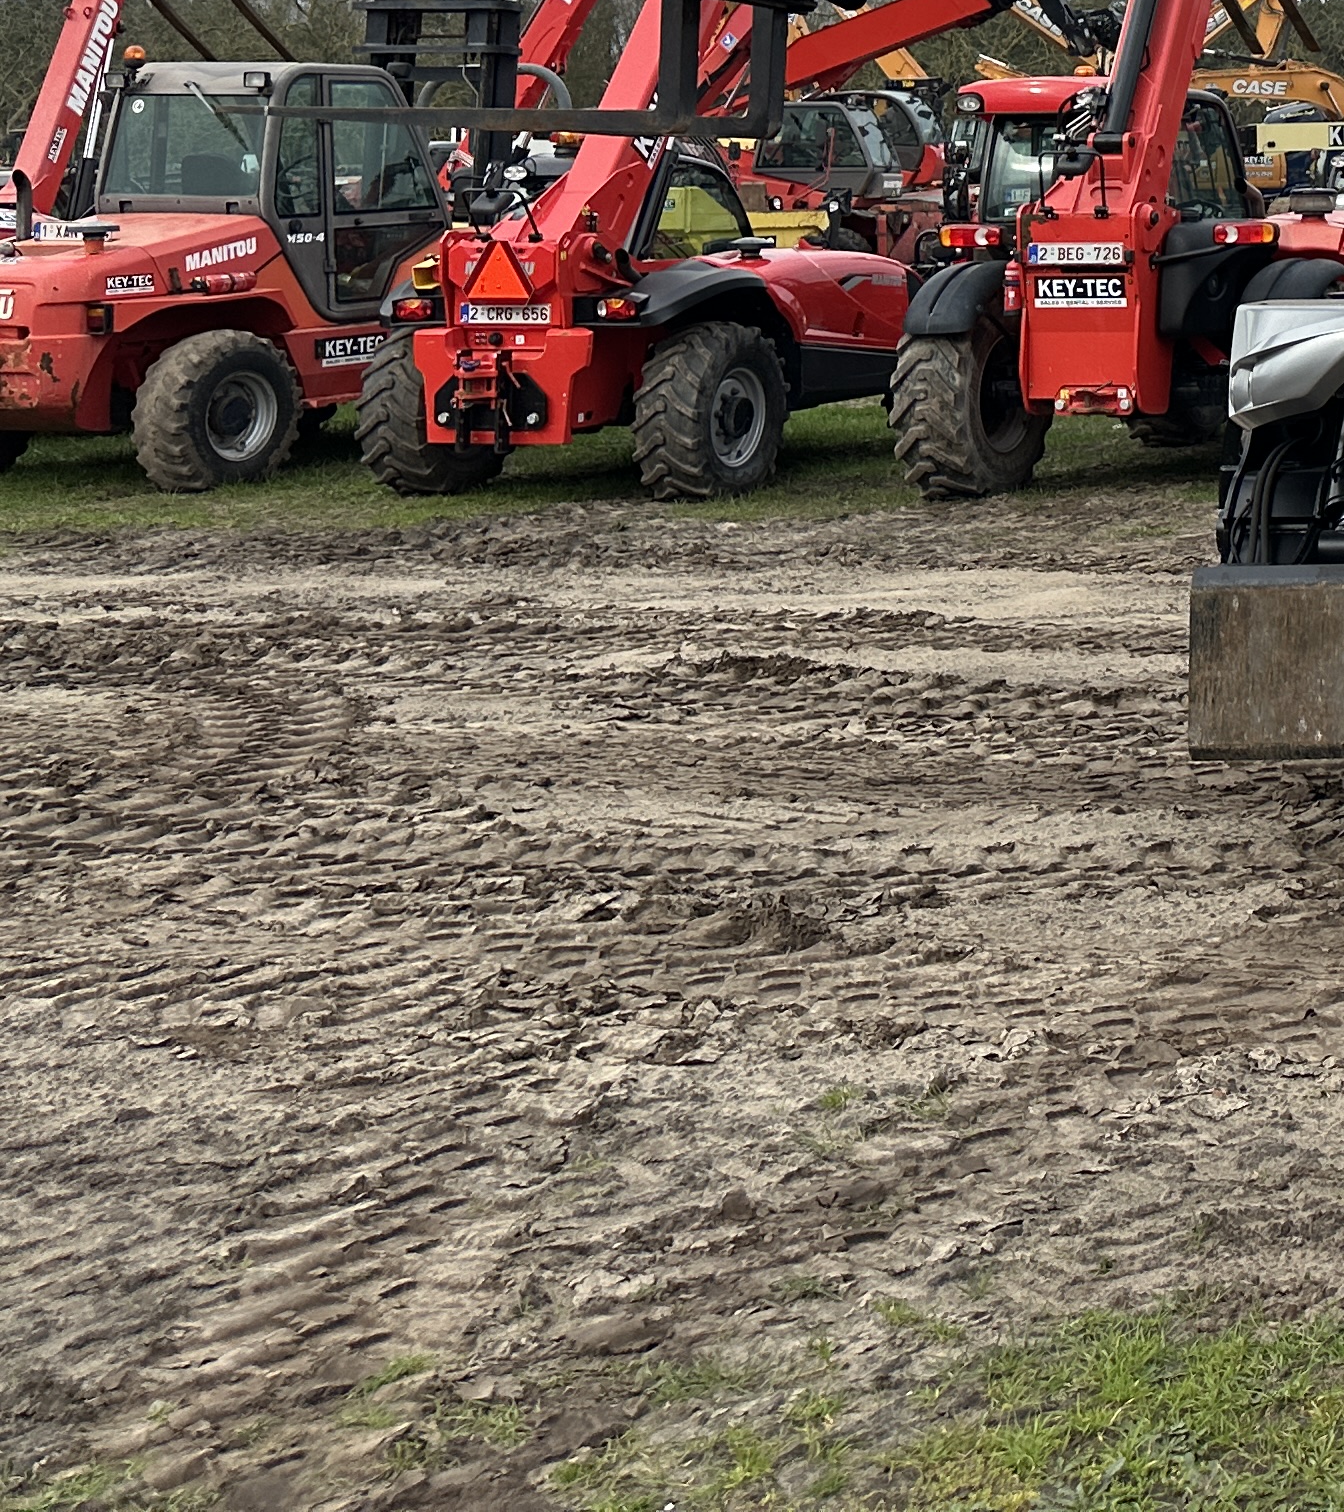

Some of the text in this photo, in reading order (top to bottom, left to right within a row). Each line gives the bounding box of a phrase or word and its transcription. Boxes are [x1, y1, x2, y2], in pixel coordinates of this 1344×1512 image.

[1232, 79, 1288, 95] CASE
[185, 236, 257, 272] MANITOU
[106, 274, 153, 289] KEY-TEC
[1037, 278, 1122, 298] KEY-TEC
